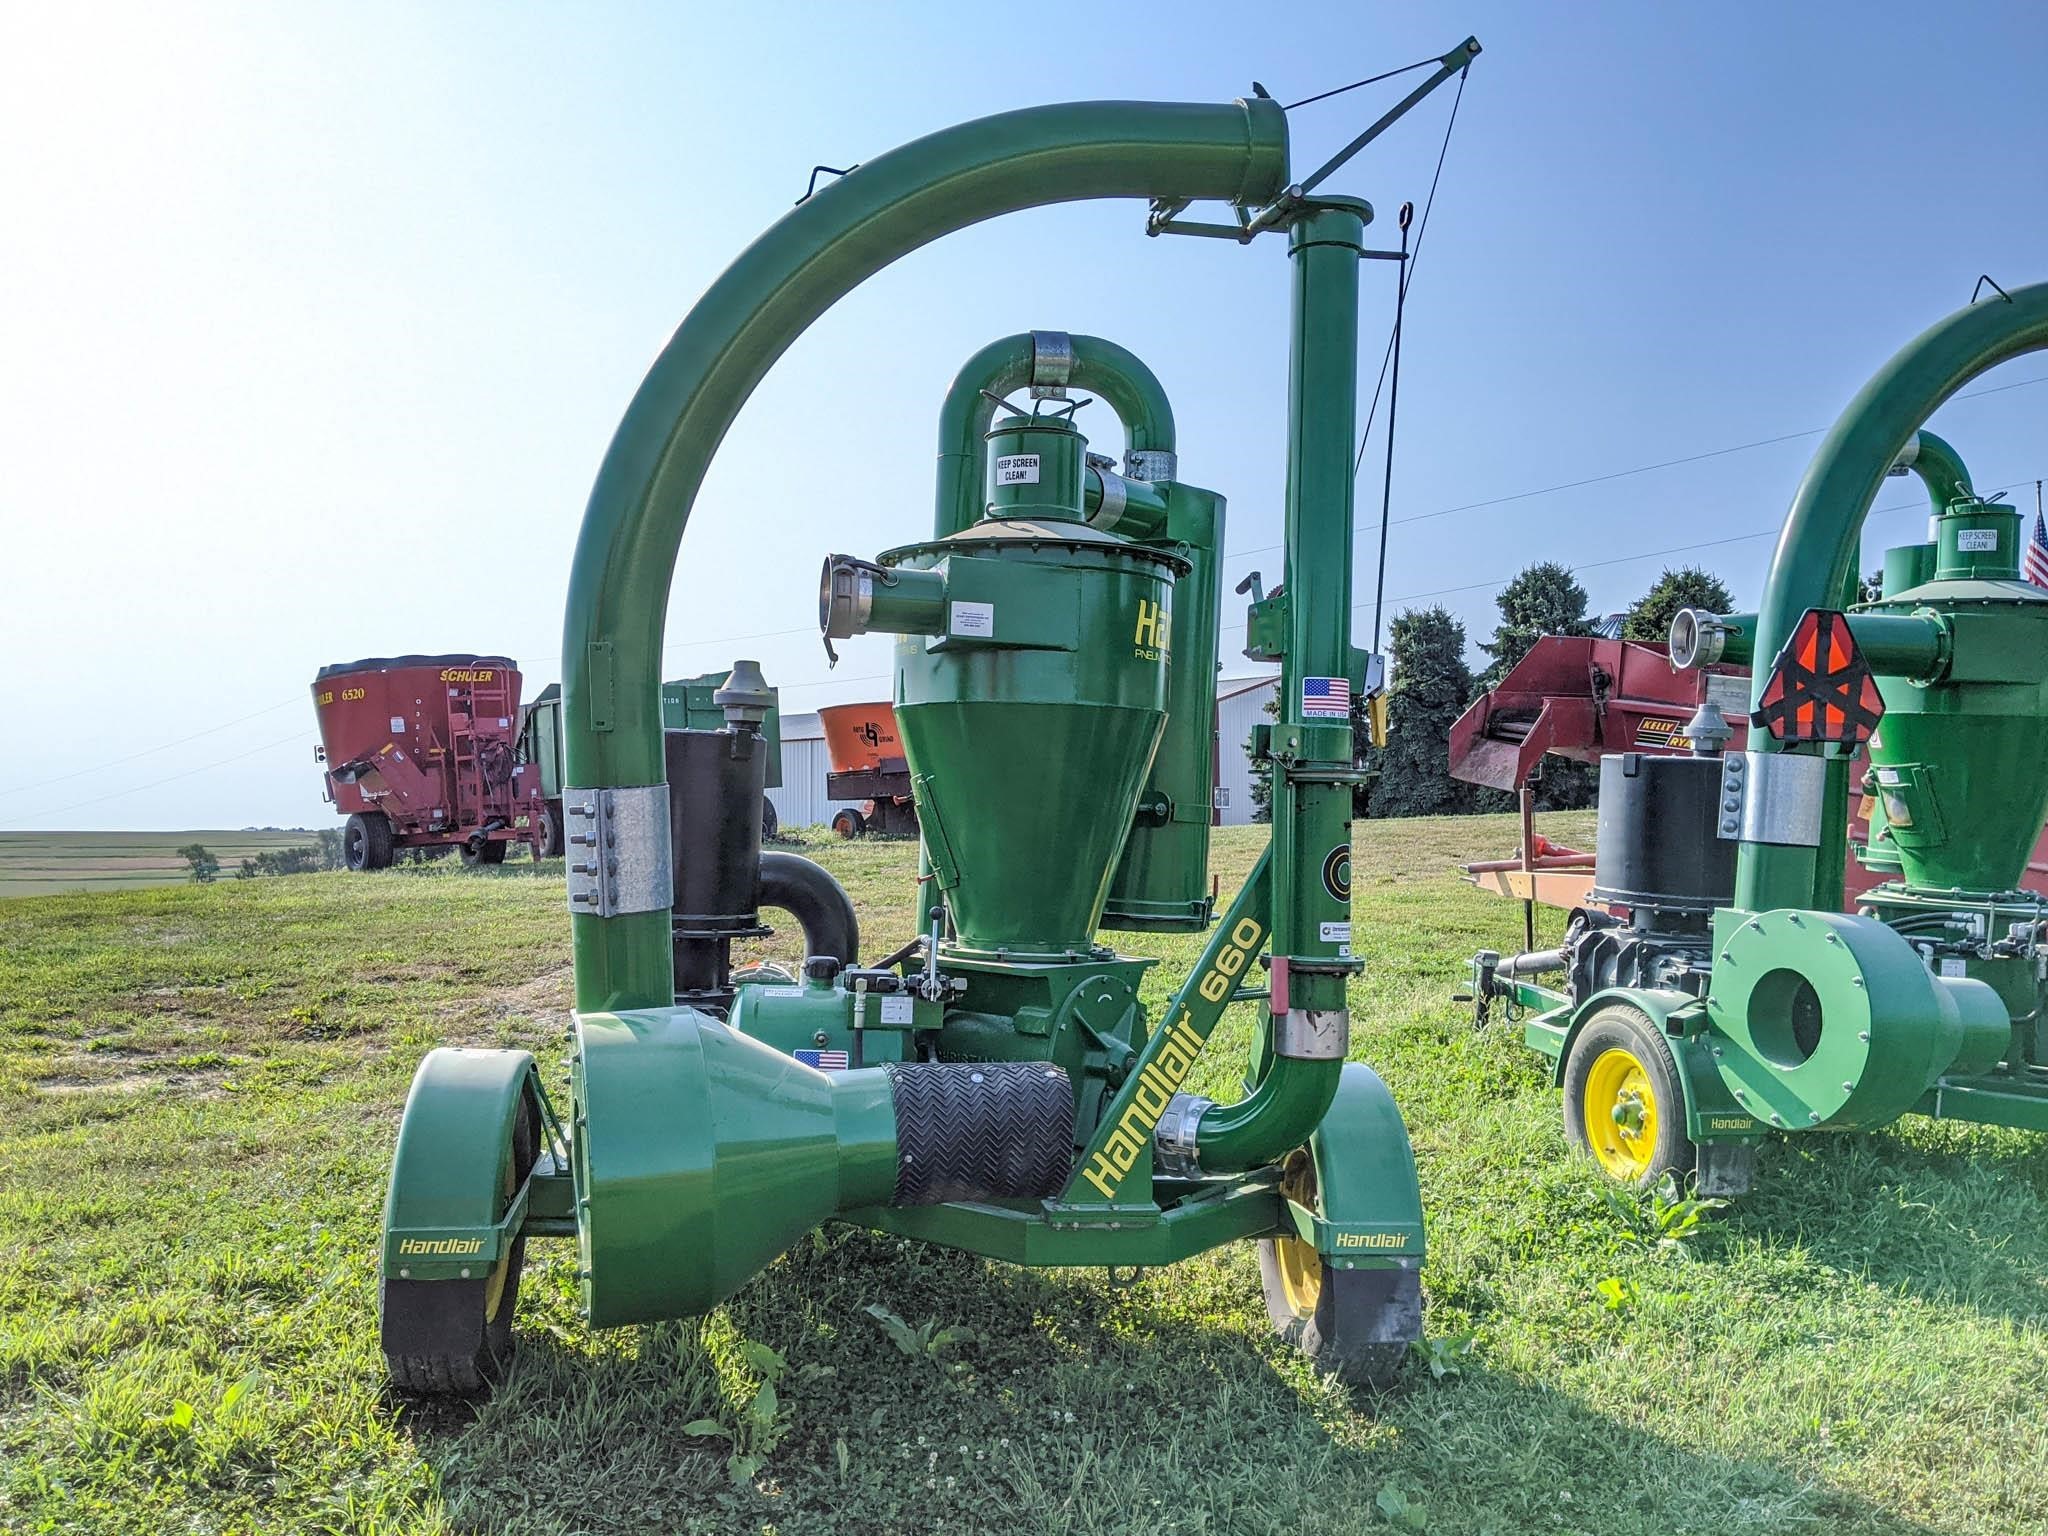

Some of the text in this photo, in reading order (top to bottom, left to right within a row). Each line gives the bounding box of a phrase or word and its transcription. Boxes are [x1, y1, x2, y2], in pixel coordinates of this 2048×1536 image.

[998, 457, 1038, 470] KEEP SCREEN
[1005, 470, 1027, 481] CLEAN!
[440, 670, 493, 682] SCHULER
[341, 687, 365, 701] 6520
[1643, 720, 1674, 732] KELLY
[1669, 736, 1692, 748] RYA
[1082, 917, 1262, 1199] Handlair 660
[1711, 1117, 1752, 1129] Handlair
[399, 1237, 486, 1255] Handlair
[1336, 1232, 1410, 1248] Handlair
